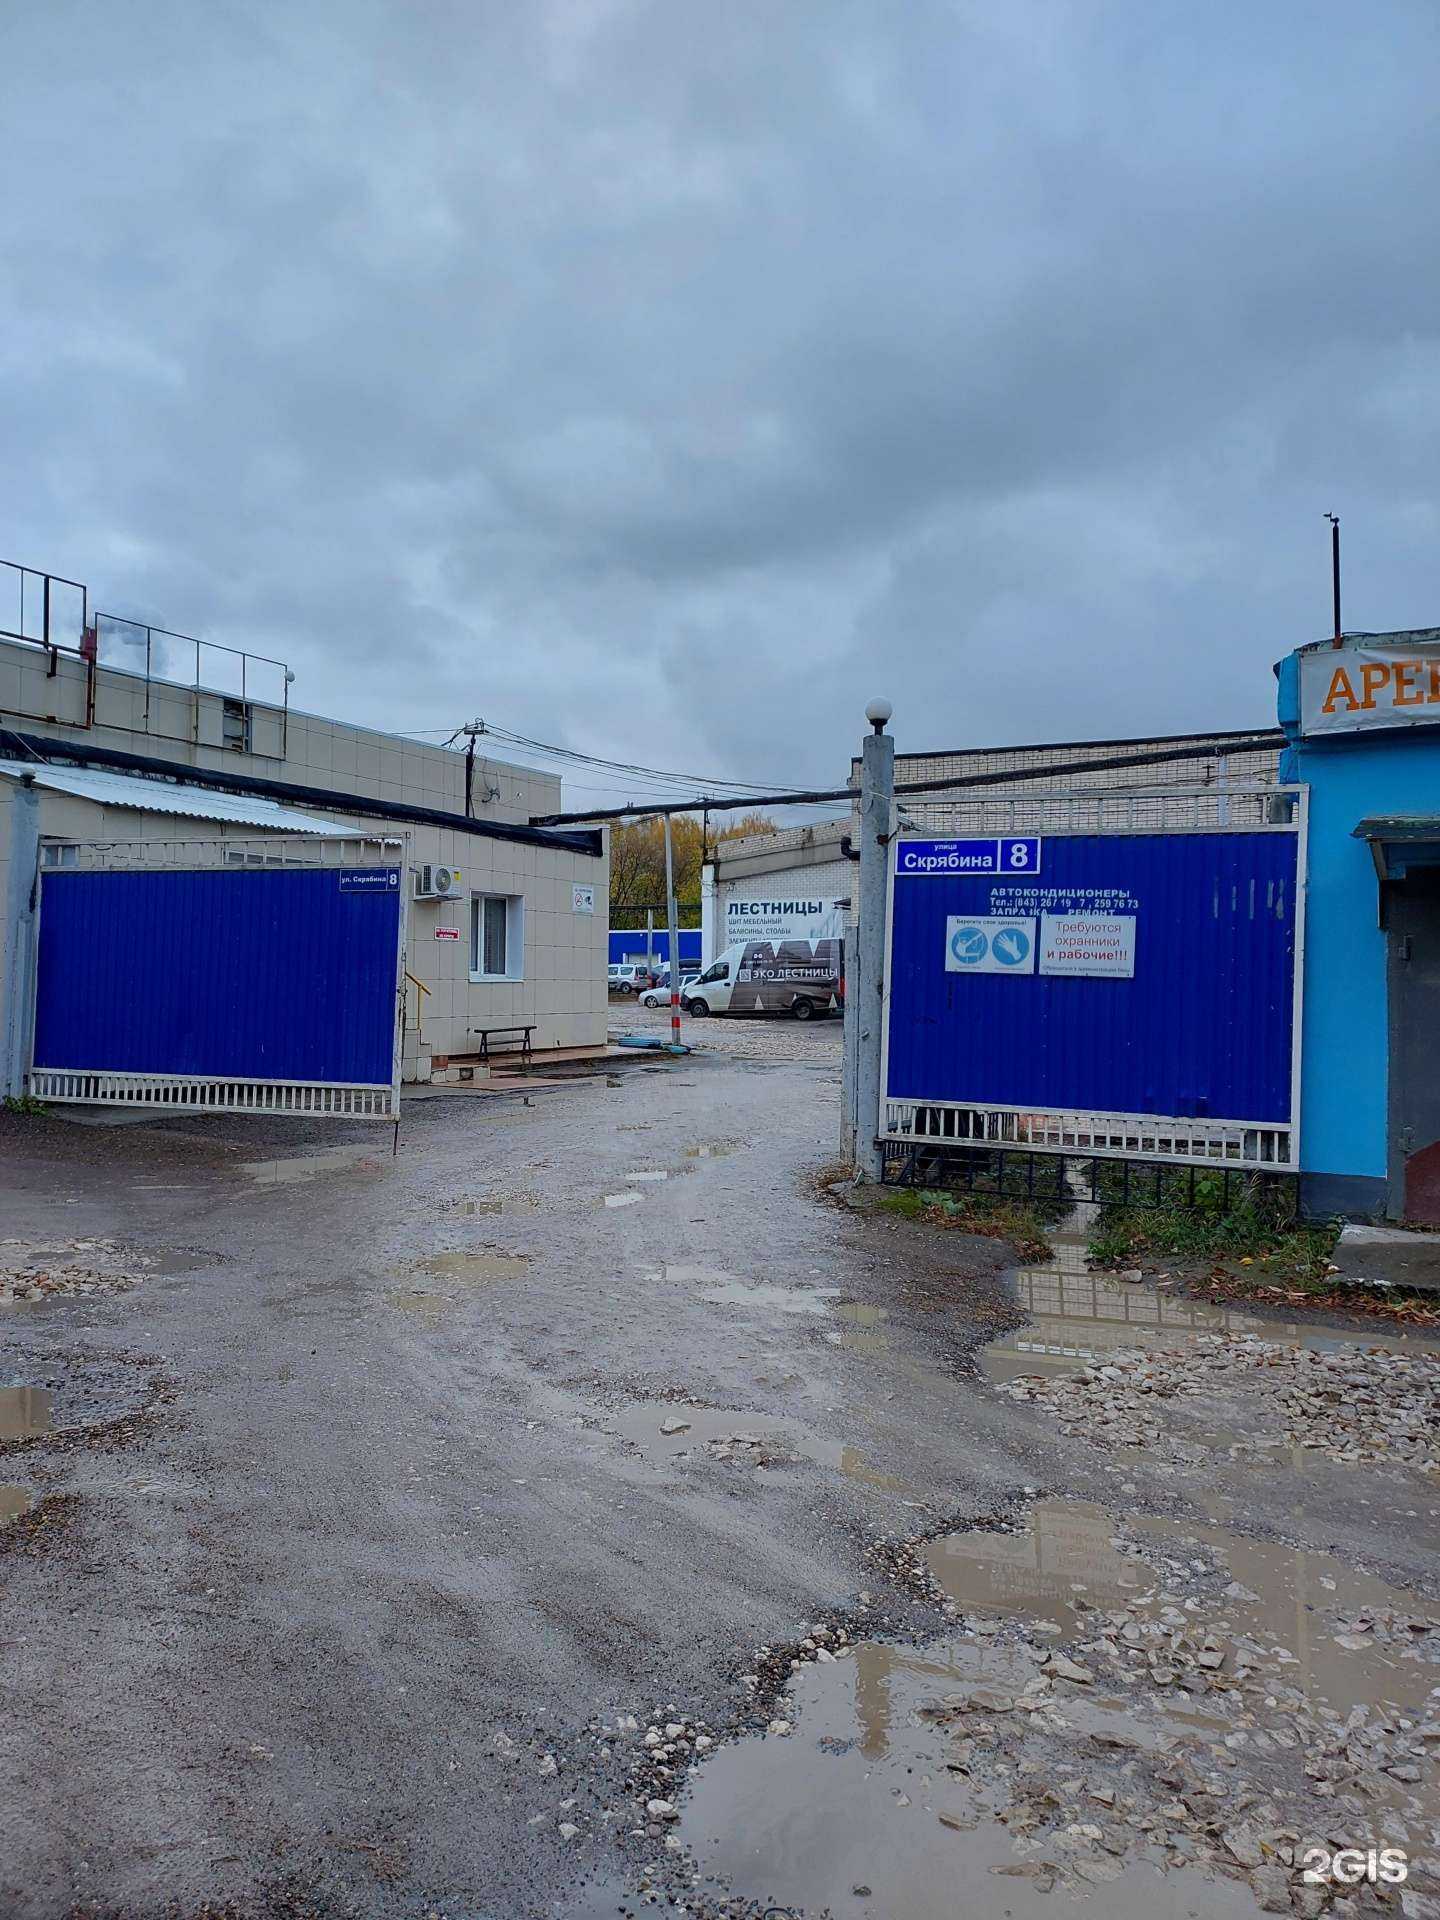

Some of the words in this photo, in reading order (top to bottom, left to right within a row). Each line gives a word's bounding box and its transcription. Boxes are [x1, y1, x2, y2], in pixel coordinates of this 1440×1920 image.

[934, 843, 958, 851] улица
[904, 852, 993, 871] Скрябина
[1010, 843, 1028, 867] 8
[389, 873, 397, 885] 8
[990, 887, 1130, 898] АВТОКОНДИЦИОНЕРЫ
[728, 901, 822, 916] ЛЕСТНИЦЫ
[1094, 899, 1112, 908] 259
[1113, 899, 1125, 908] 76
[1127, 899, 1139, 909] 73
[1067, 909, 1116, 917] РЕМОНТ
[1055, 921, 1121, 935] Требуются
[1055, 936, 1120, 947] охранники
[1047, 950, 1055, 959] и
[1058, 948, 1128, 962] рабочие!!!
[752, 969, 775, 979] ЭКО
[777, 967, 838, 979] ЛЕСТНИЦЫ
